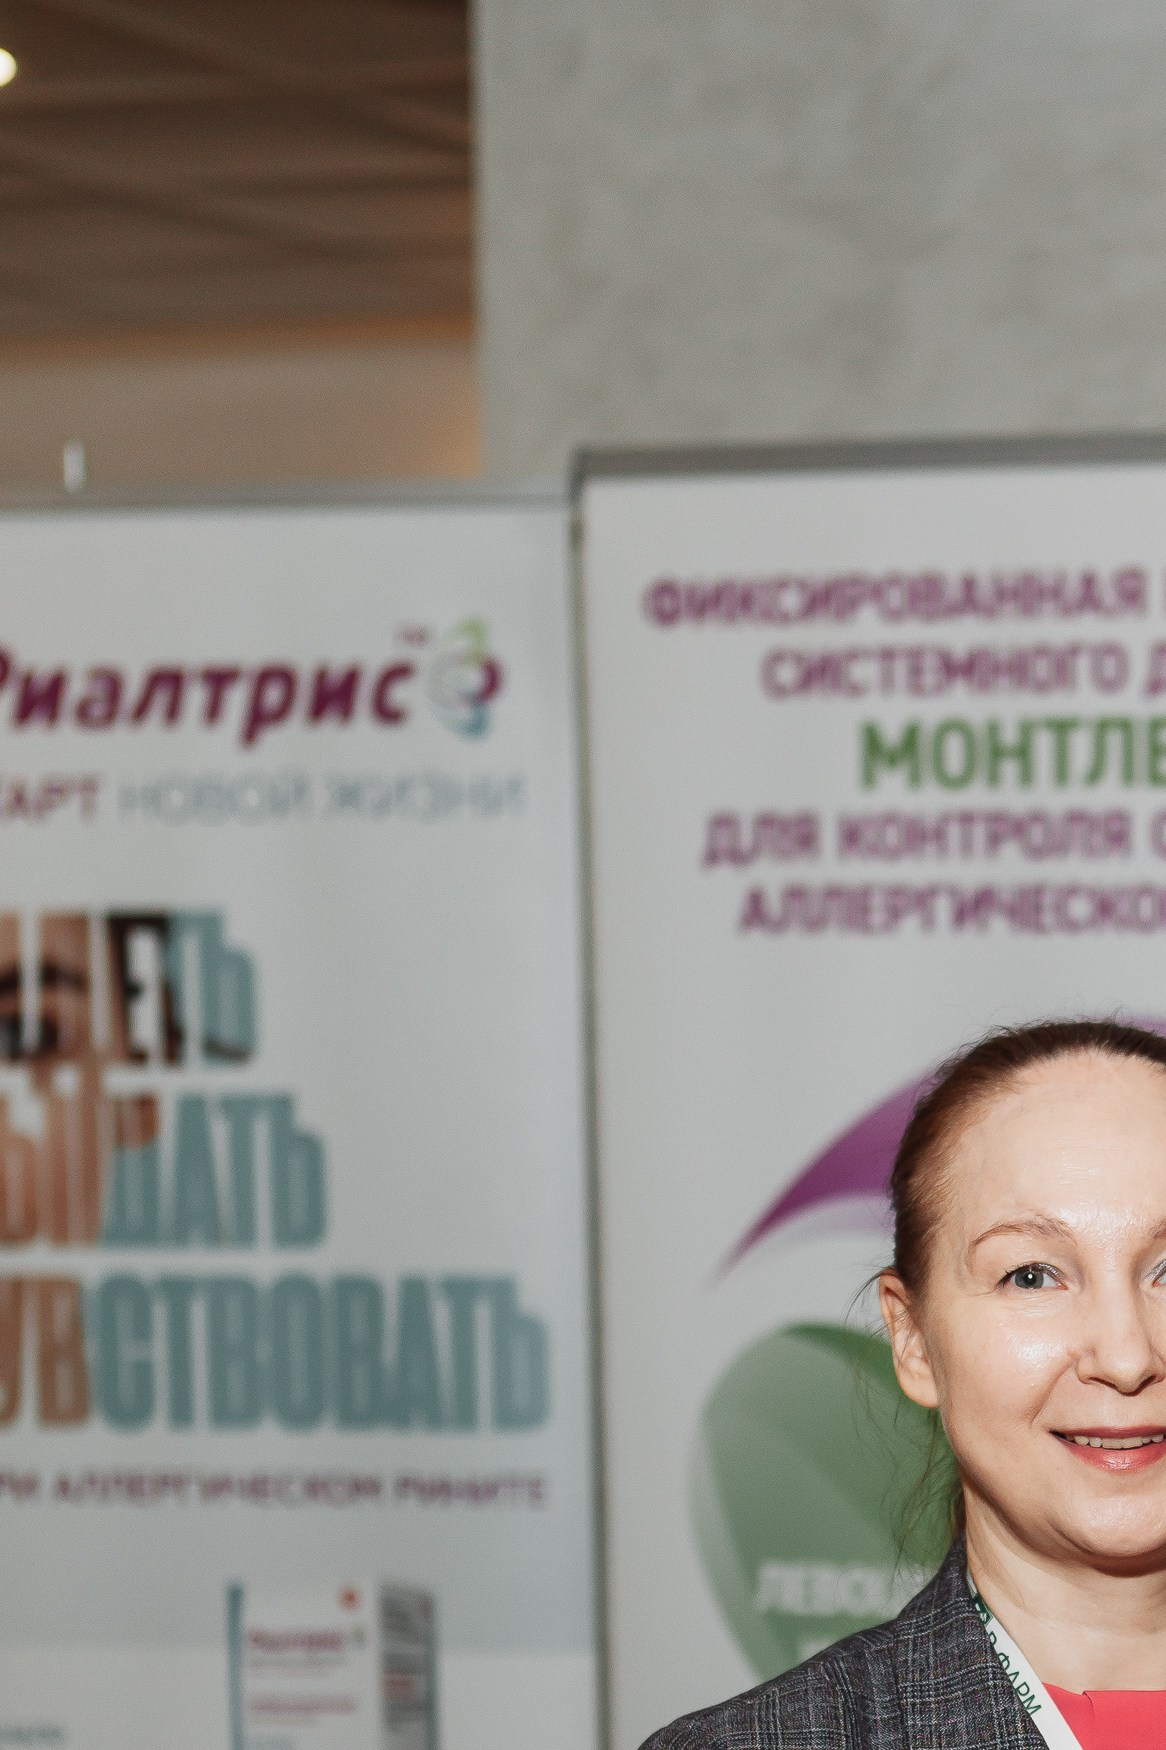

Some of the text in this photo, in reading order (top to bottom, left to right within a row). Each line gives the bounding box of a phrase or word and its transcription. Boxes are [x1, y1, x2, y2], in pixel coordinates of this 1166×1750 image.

[643, 564, 1146, 628] ФИКСИРОВАННАЯ
[763, 641, 1130, 699] СИСТЕМНОГО
[702, 813, 818, 870] ДЛЯ
[840, 811, 1131, 862] КОНТРОЛЯ
